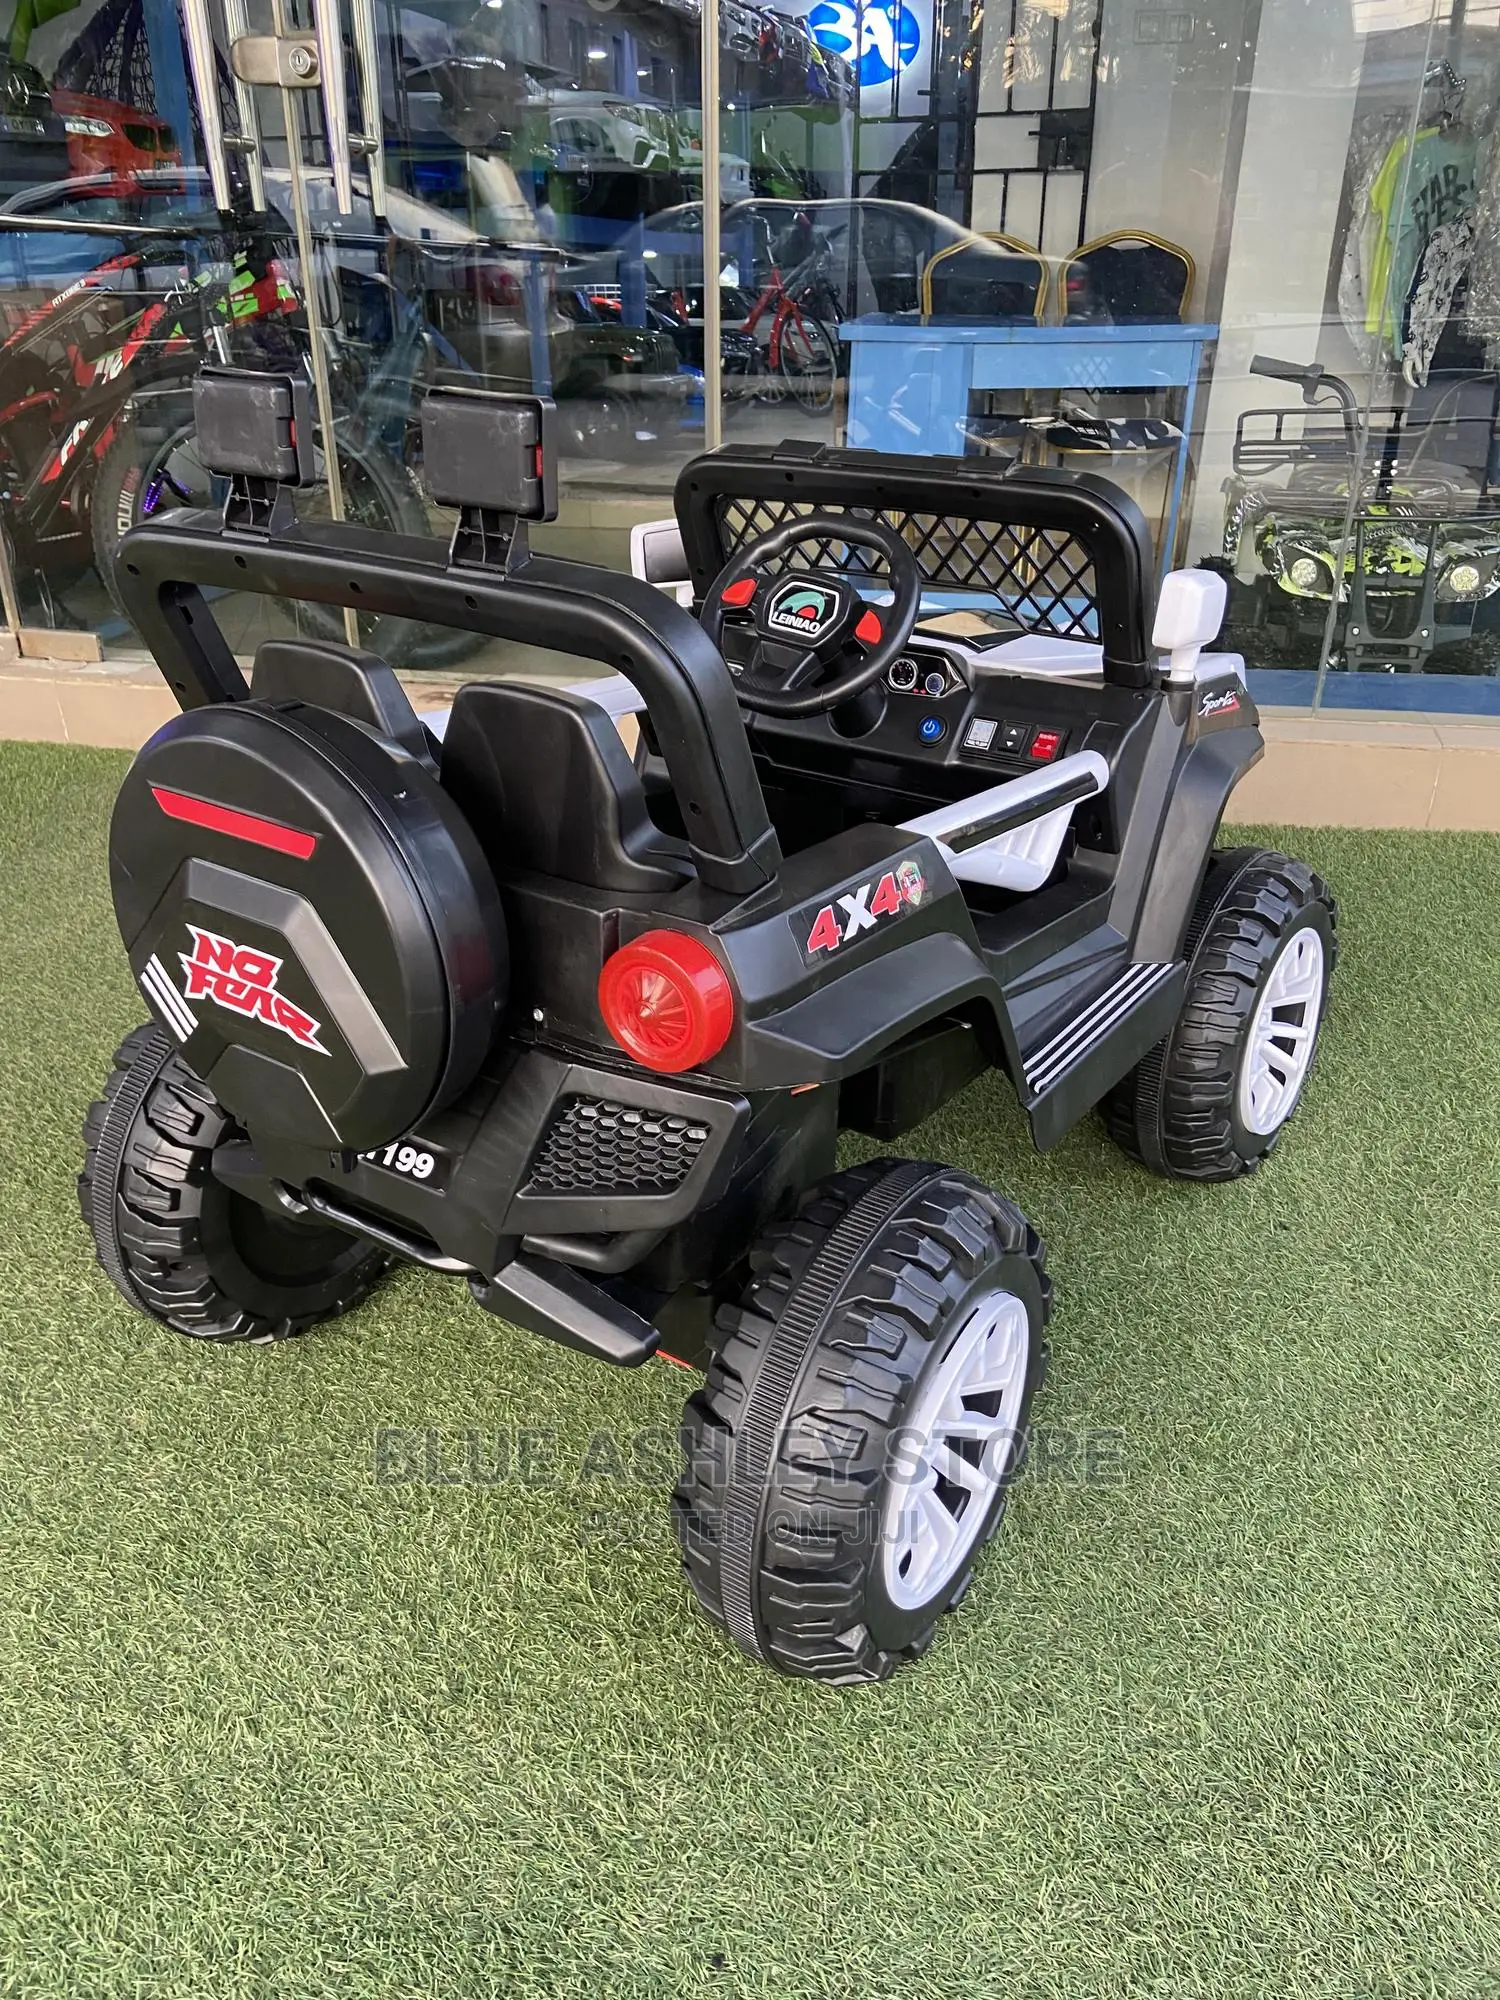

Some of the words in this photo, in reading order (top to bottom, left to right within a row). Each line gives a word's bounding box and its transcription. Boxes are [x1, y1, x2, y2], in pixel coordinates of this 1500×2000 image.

[771, 611, 821, 633] LEINIAO
[806, 872, 902, 953] 4X4
[185, 922, 284, 990] NO
[177, 951, 333, 1057] FEAR
